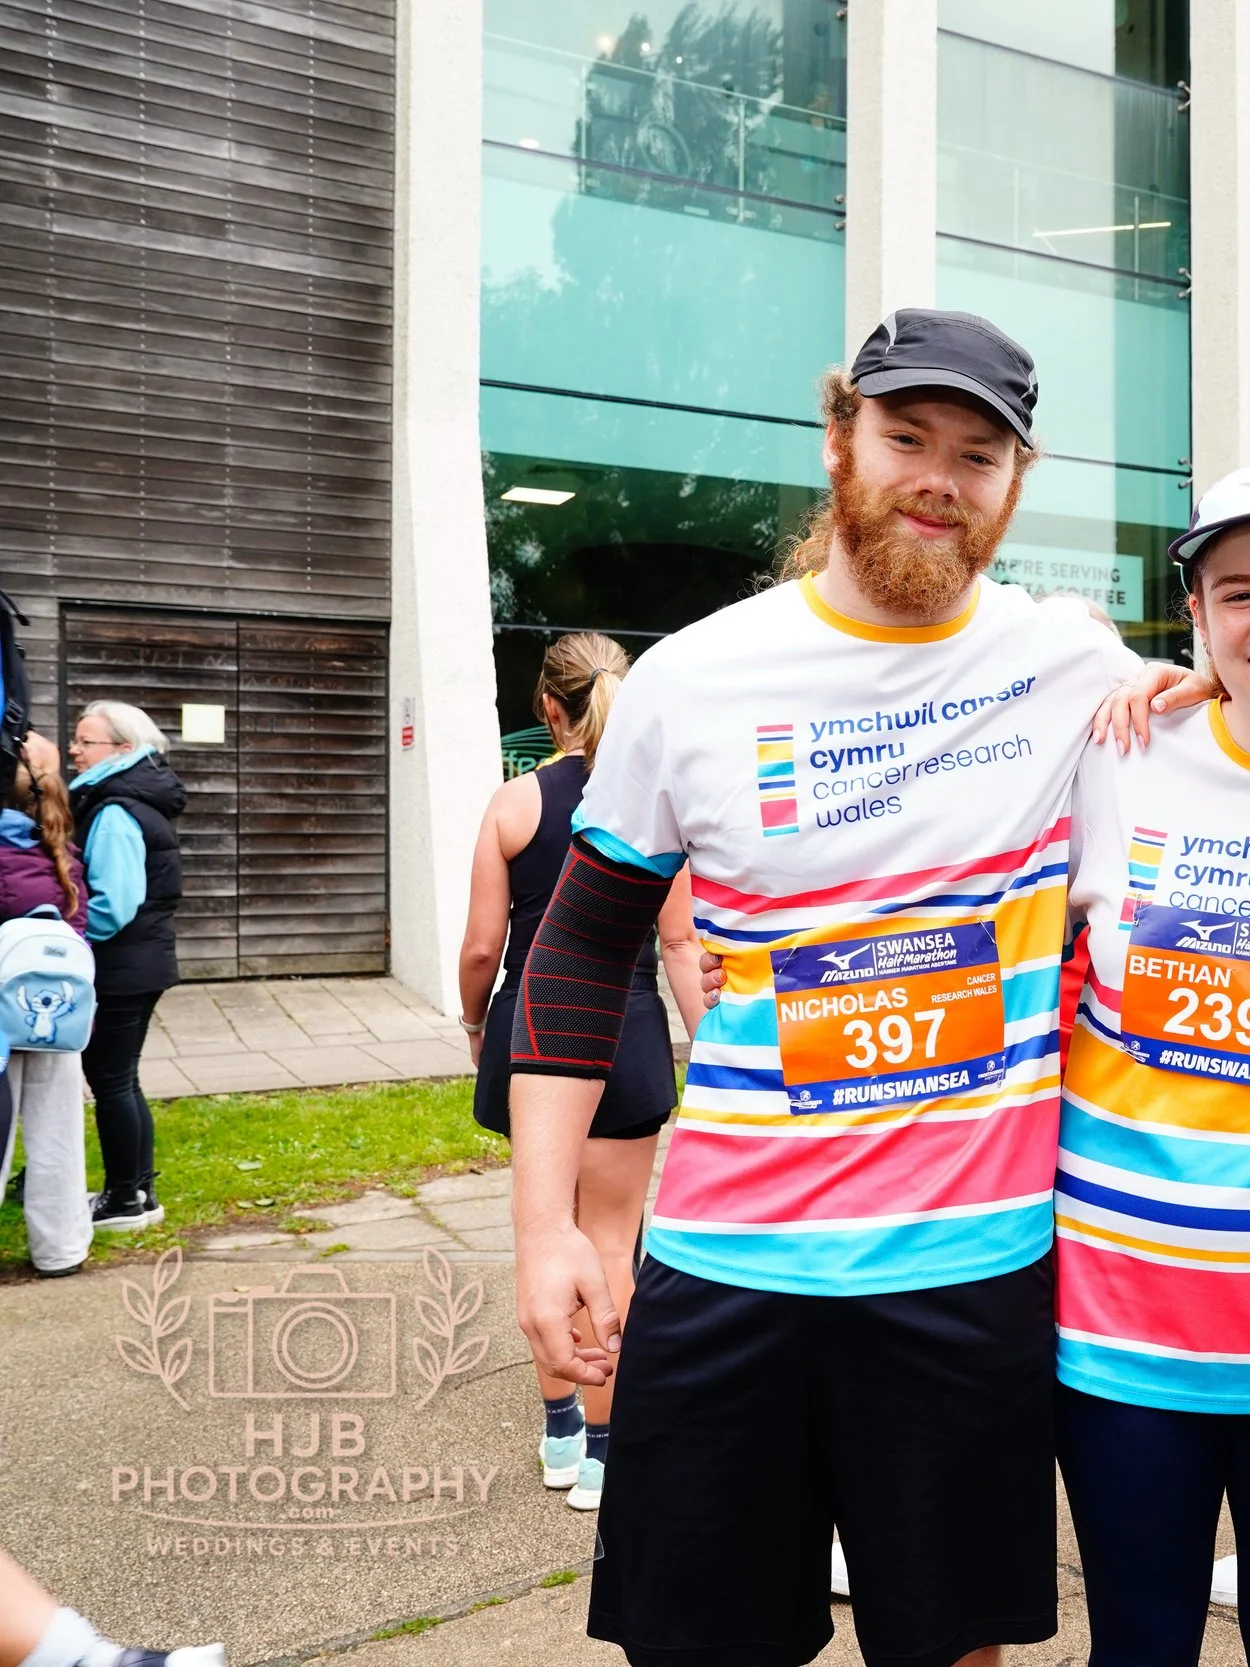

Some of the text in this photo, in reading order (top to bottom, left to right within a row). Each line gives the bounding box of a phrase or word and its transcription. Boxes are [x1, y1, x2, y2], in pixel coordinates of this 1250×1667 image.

[1050, 562, 1120, 583] SERVING
[810, 701, 937, 743] ymchwil
[810, 742, 905, 774] cymru
[813, 734, 1032, 800] cancer research
[816, 796, 902, 829] wales
[877, 932, 956, 957] SWANSEA
[901, 963, 930, 972] MARATHON
[930, 959, 957, 968] ABERTAWE
[966, 973, 996, 986] CANCER
[1128, 954, 1232, 988] BETHAN
[781, 987, 909, 1023] NICHOLAS
[931, 985, 998, 1004] RESEARCH WALES
[842, 1008, 946, 1069] 397
[832, 1069, 970, 1106] #RUNSWANSEA
